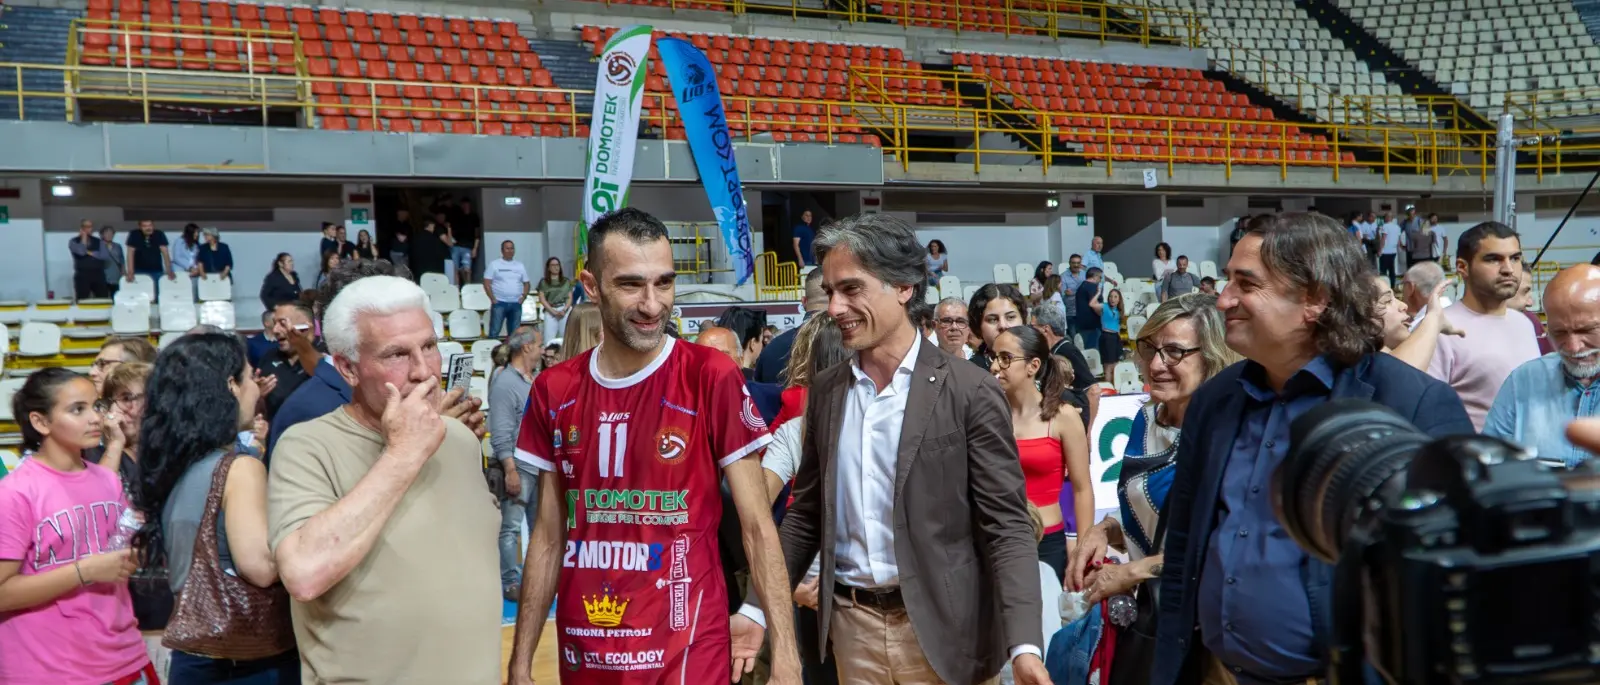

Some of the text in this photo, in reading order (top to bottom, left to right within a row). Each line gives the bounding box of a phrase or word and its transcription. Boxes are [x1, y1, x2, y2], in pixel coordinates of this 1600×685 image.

[595, 92, 618, 174] DOMOTEK
[597, 422, 628, 478] 11
[584, 489, 690, 511] DOMOTEK
[34, 501, 123, 571] NIK
[674, 583, 685, 628] DROGHERIA
[565, 627, 653, 638] CORONA PETROLI
[583, 649, 665, 665] CTL ECOLOGY
